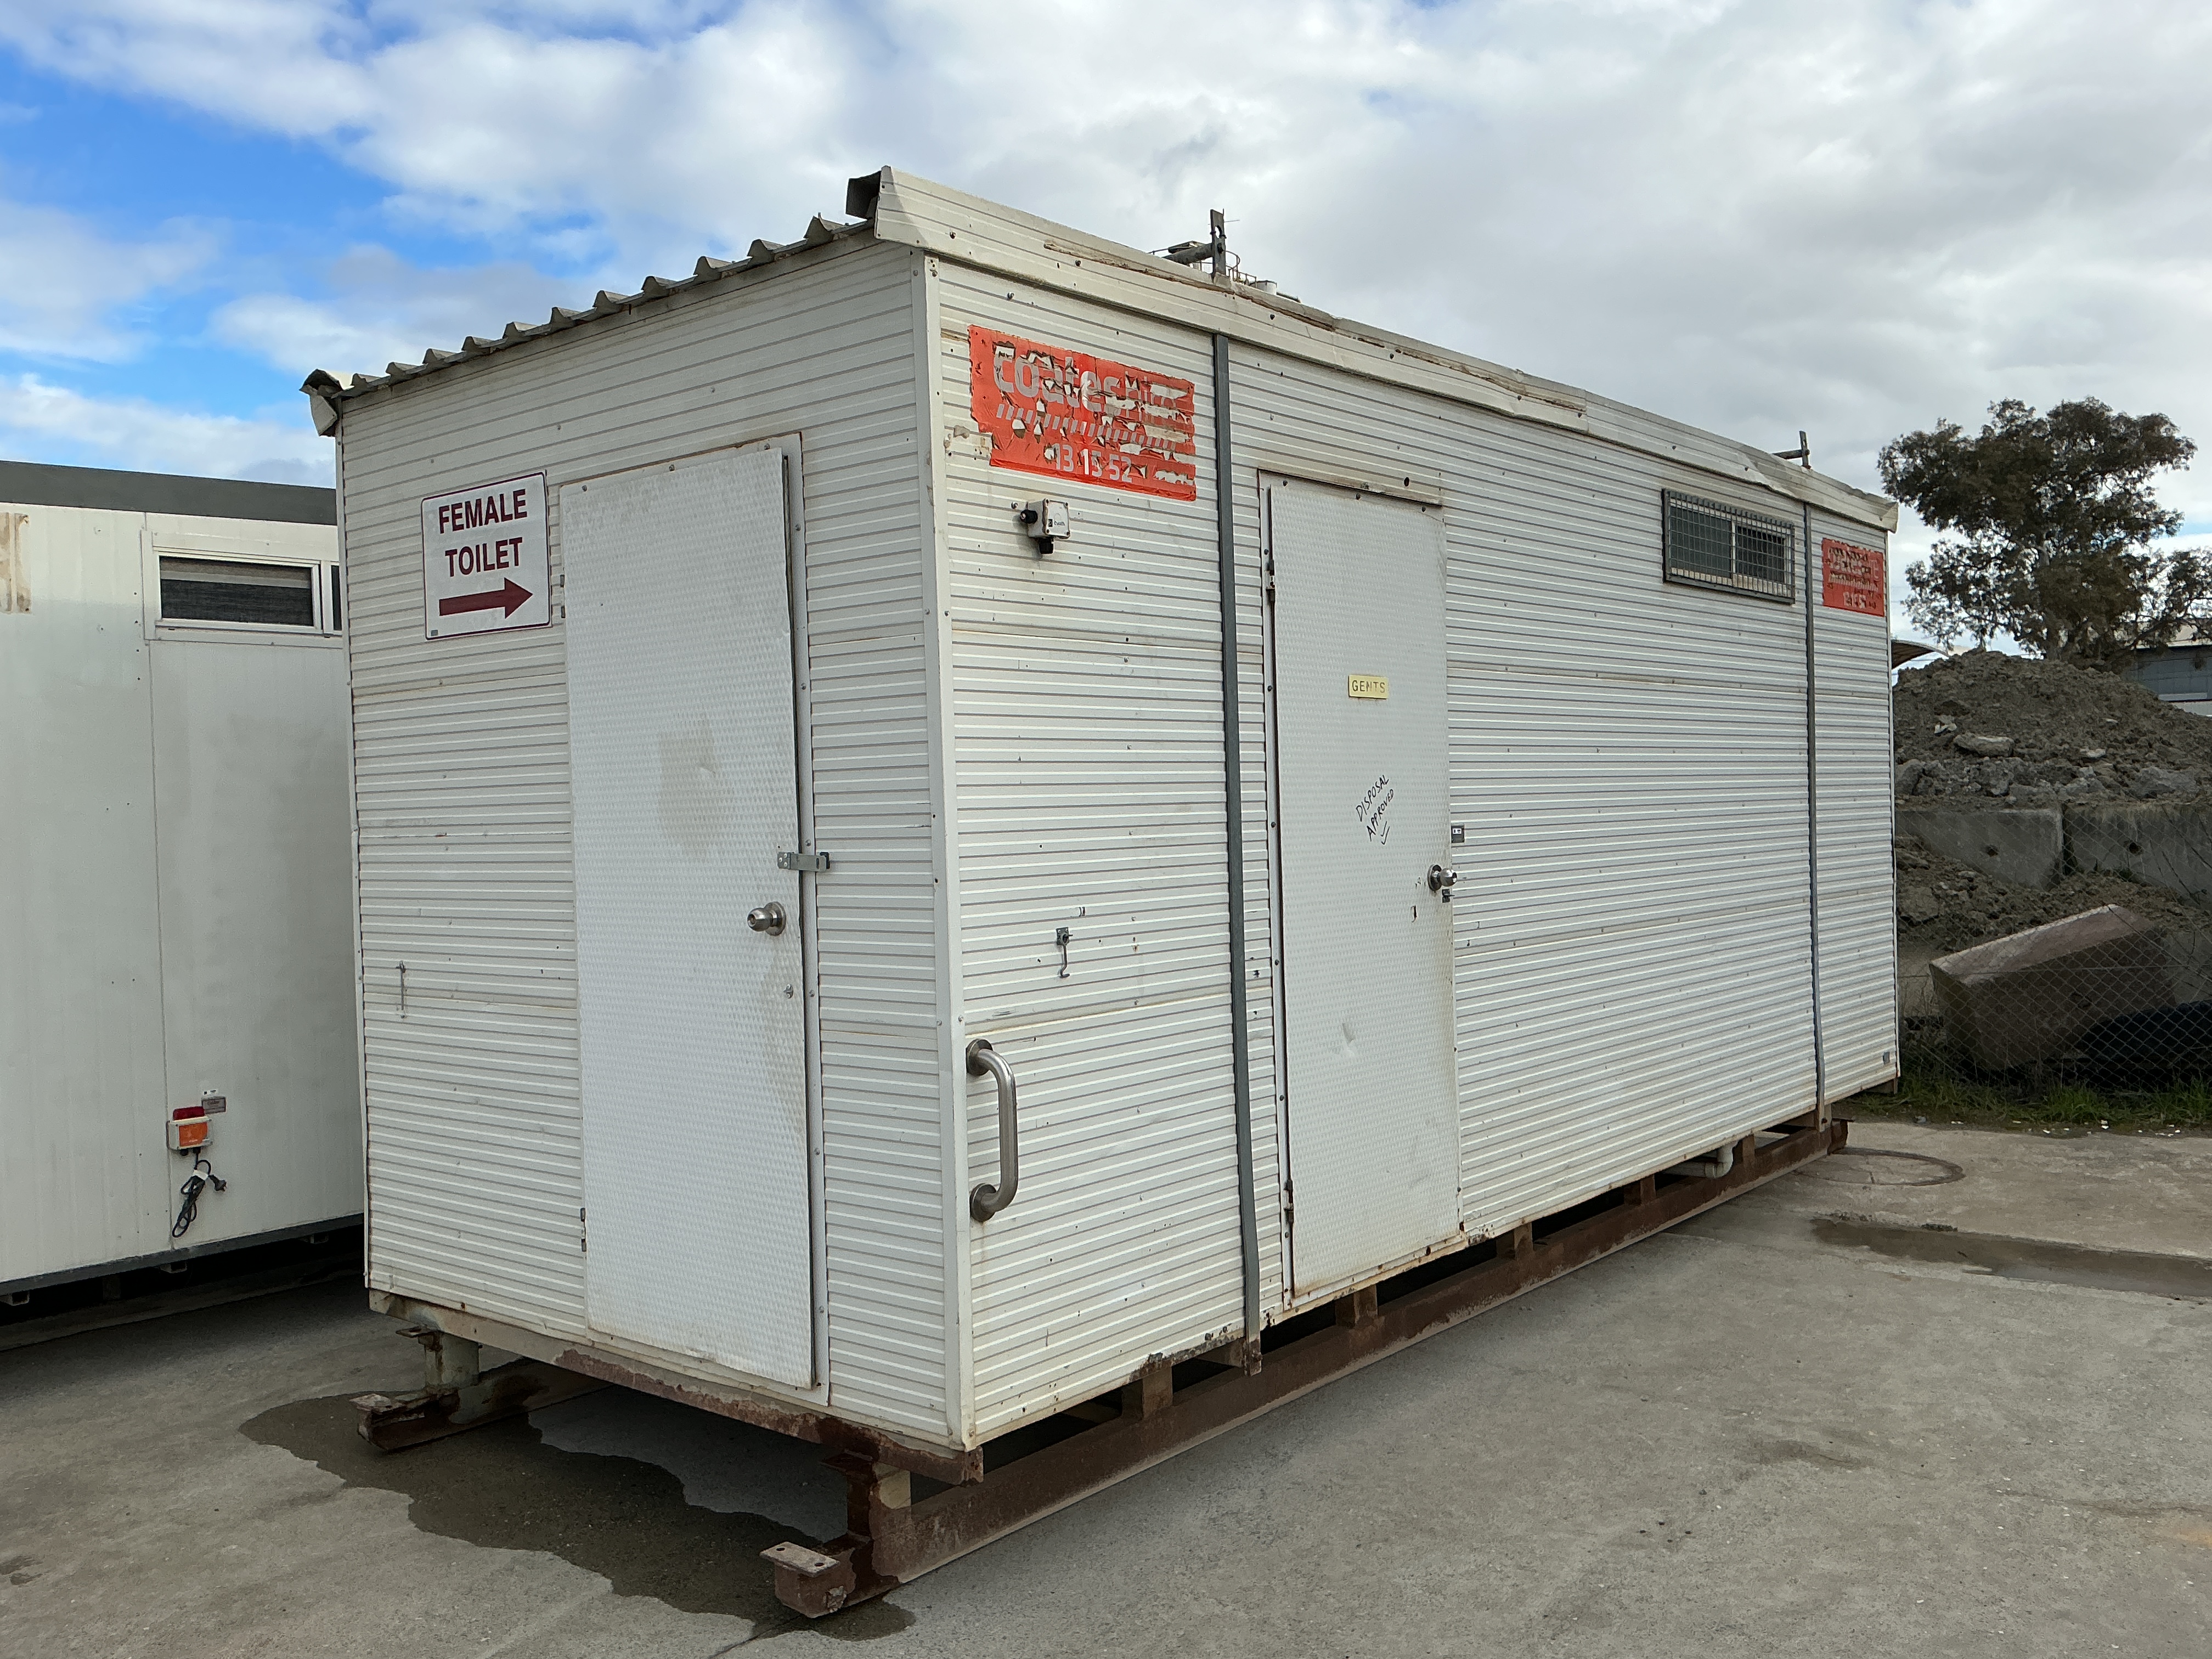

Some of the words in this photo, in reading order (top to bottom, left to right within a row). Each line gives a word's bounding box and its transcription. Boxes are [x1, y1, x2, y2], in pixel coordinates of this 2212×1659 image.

[1109, 453, 1132, 483] 52
[438, 488, 528, 534] FEMALE
[445, 537, 523, 577] TOILET
[1352, 680, 1385, 693] GENTS
[1355, 774, 1390, 822] DISPOSAL
[1366, 788, 1394, 842] APPROVED
